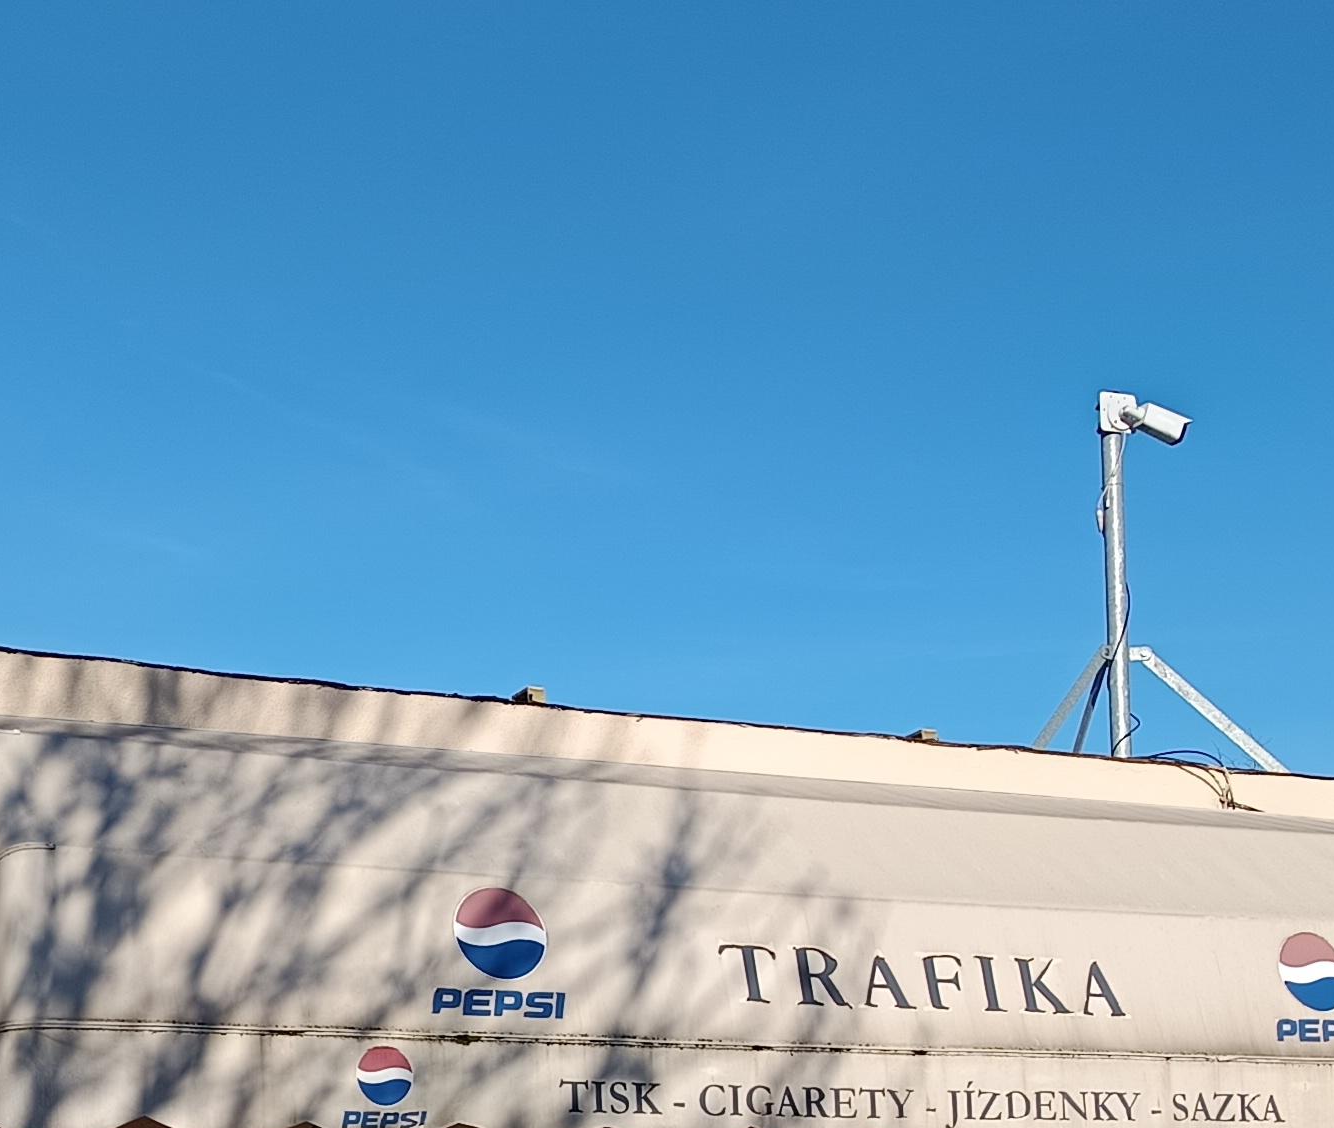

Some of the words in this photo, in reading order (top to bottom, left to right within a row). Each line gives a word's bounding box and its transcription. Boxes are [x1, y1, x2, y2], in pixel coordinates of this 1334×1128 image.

[719, 943, 1127, 1017] TRAFIKA
[432, 988, 565, 1019] PEPSI
[559, 1079, 663, 1114] TISK
[699, 1083, 915, 1124] CIGARETY
[1172, 1092, 1285, 1124] SAZKA
